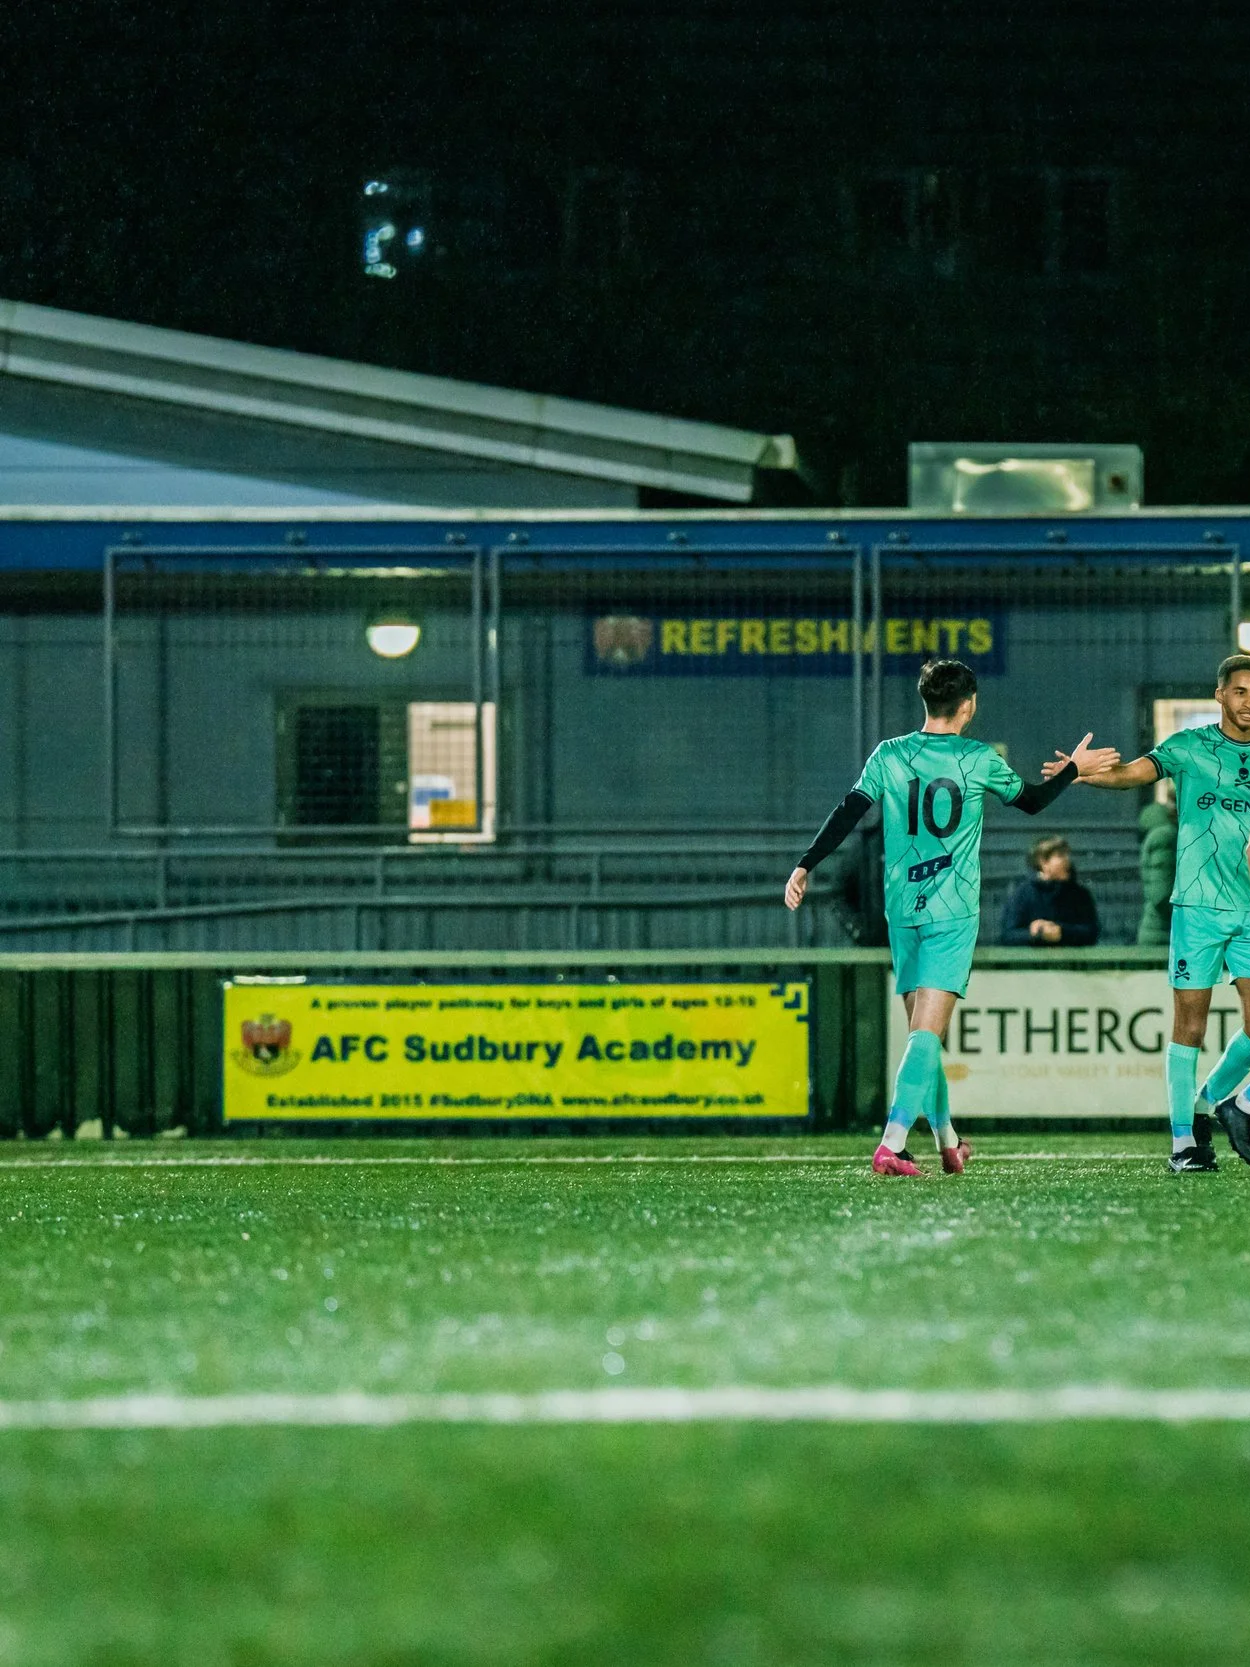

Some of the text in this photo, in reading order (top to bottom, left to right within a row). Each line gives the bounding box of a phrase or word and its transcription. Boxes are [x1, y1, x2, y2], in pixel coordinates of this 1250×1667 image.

[907, 777, 964, 839] 10
[310, 1032, 757, 1069] AFC Sudbury Academy
[943, 1006, 1238, 1053] ETHERGT
